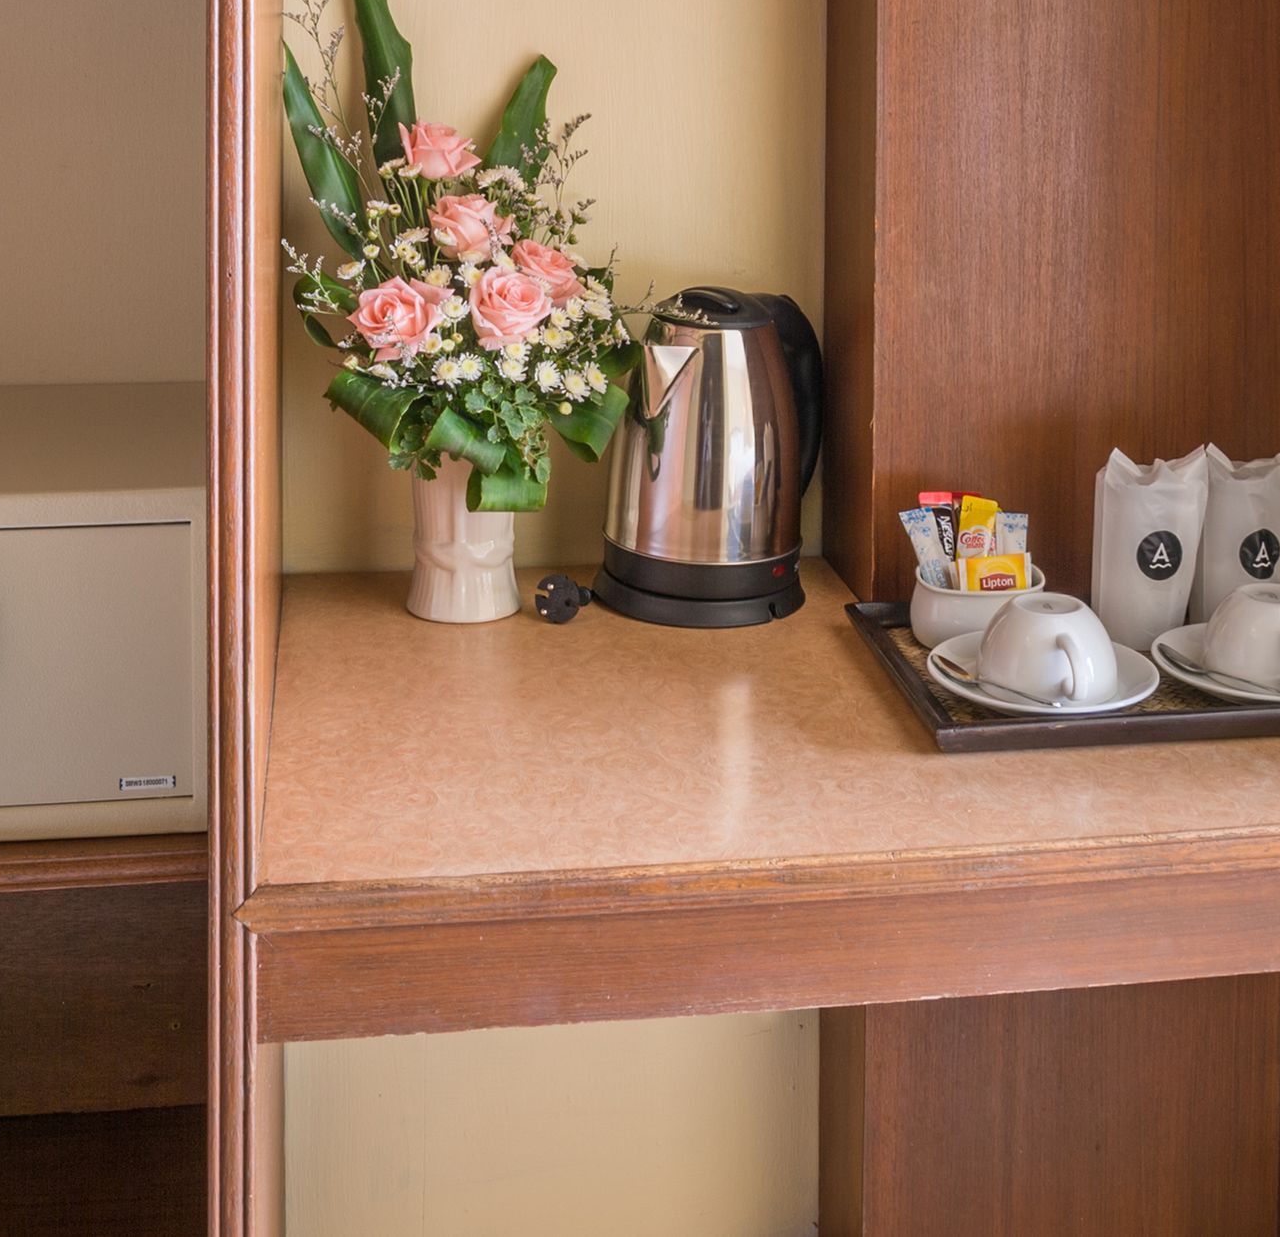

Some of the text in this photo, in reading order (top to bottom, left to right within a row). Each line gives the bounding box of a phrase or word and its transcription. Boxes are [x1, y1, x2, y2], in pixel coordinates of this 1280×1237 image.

[1152, 542, 1170, 563] A
[1255, 541, 1270, 562] A
[982, 577, 1014, 589] Lipton
